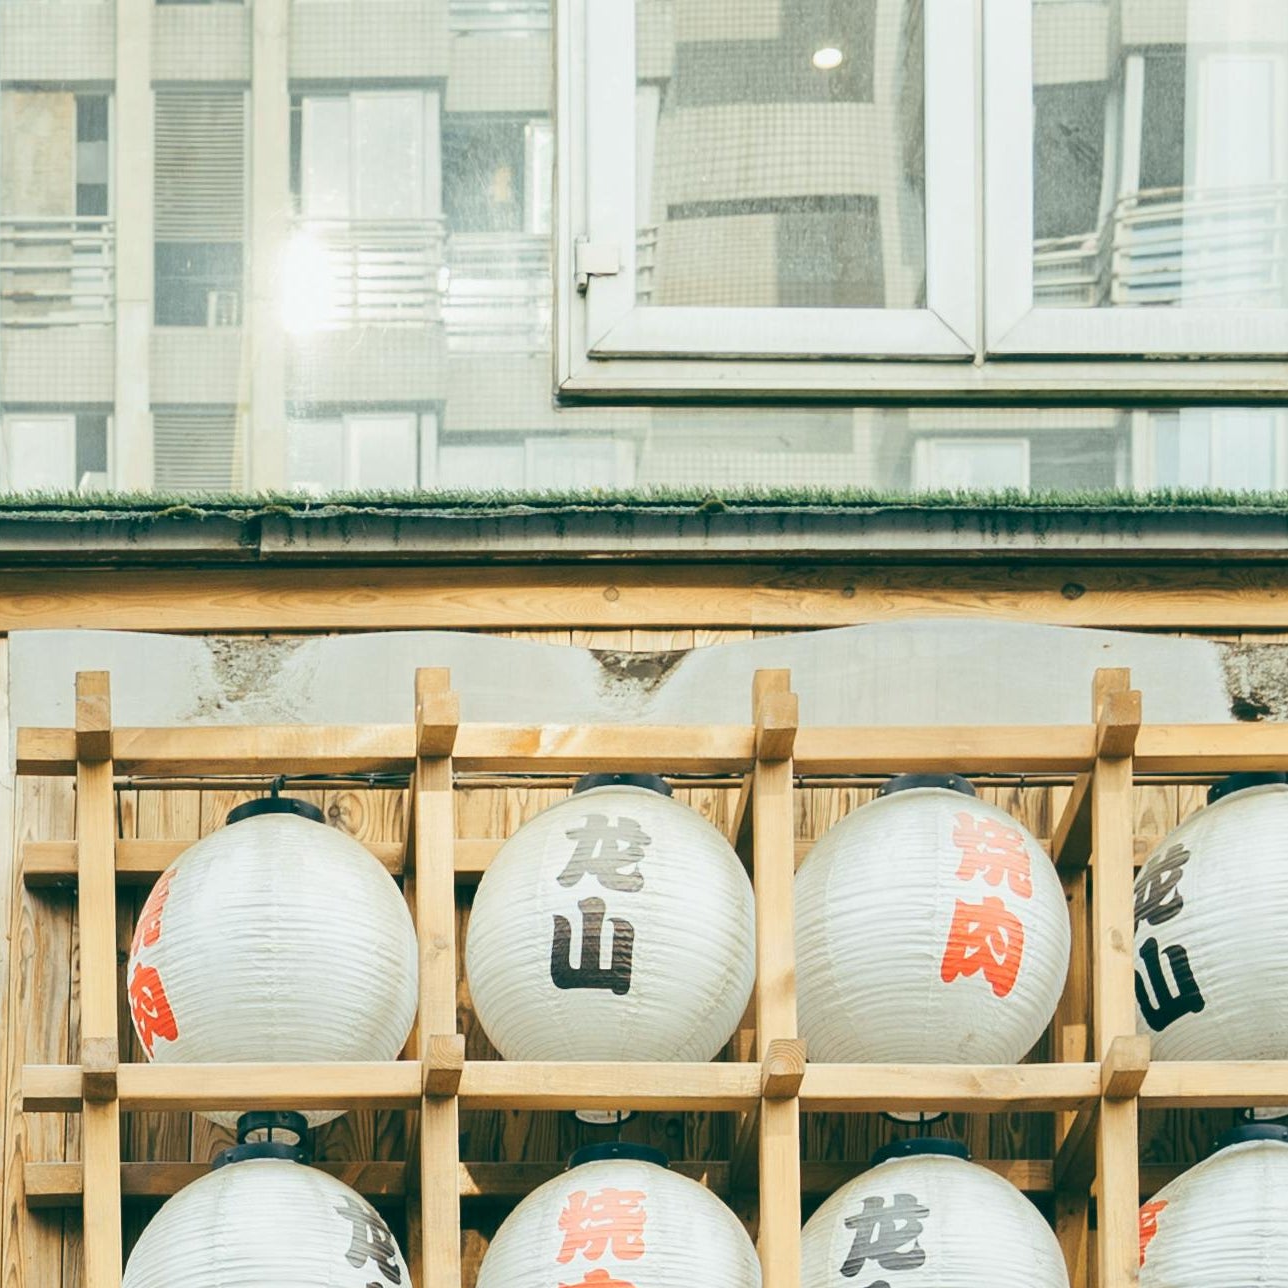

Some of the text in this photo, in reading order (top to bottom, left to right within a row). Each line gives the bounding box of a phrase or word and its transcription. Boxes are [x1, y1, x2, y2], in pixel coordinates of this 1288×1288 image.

[550, 813, 652, 996] 龙山
[939, 808, 1033, 999] 烧肉
[1134, 841, 1206, 1033] 龙山
